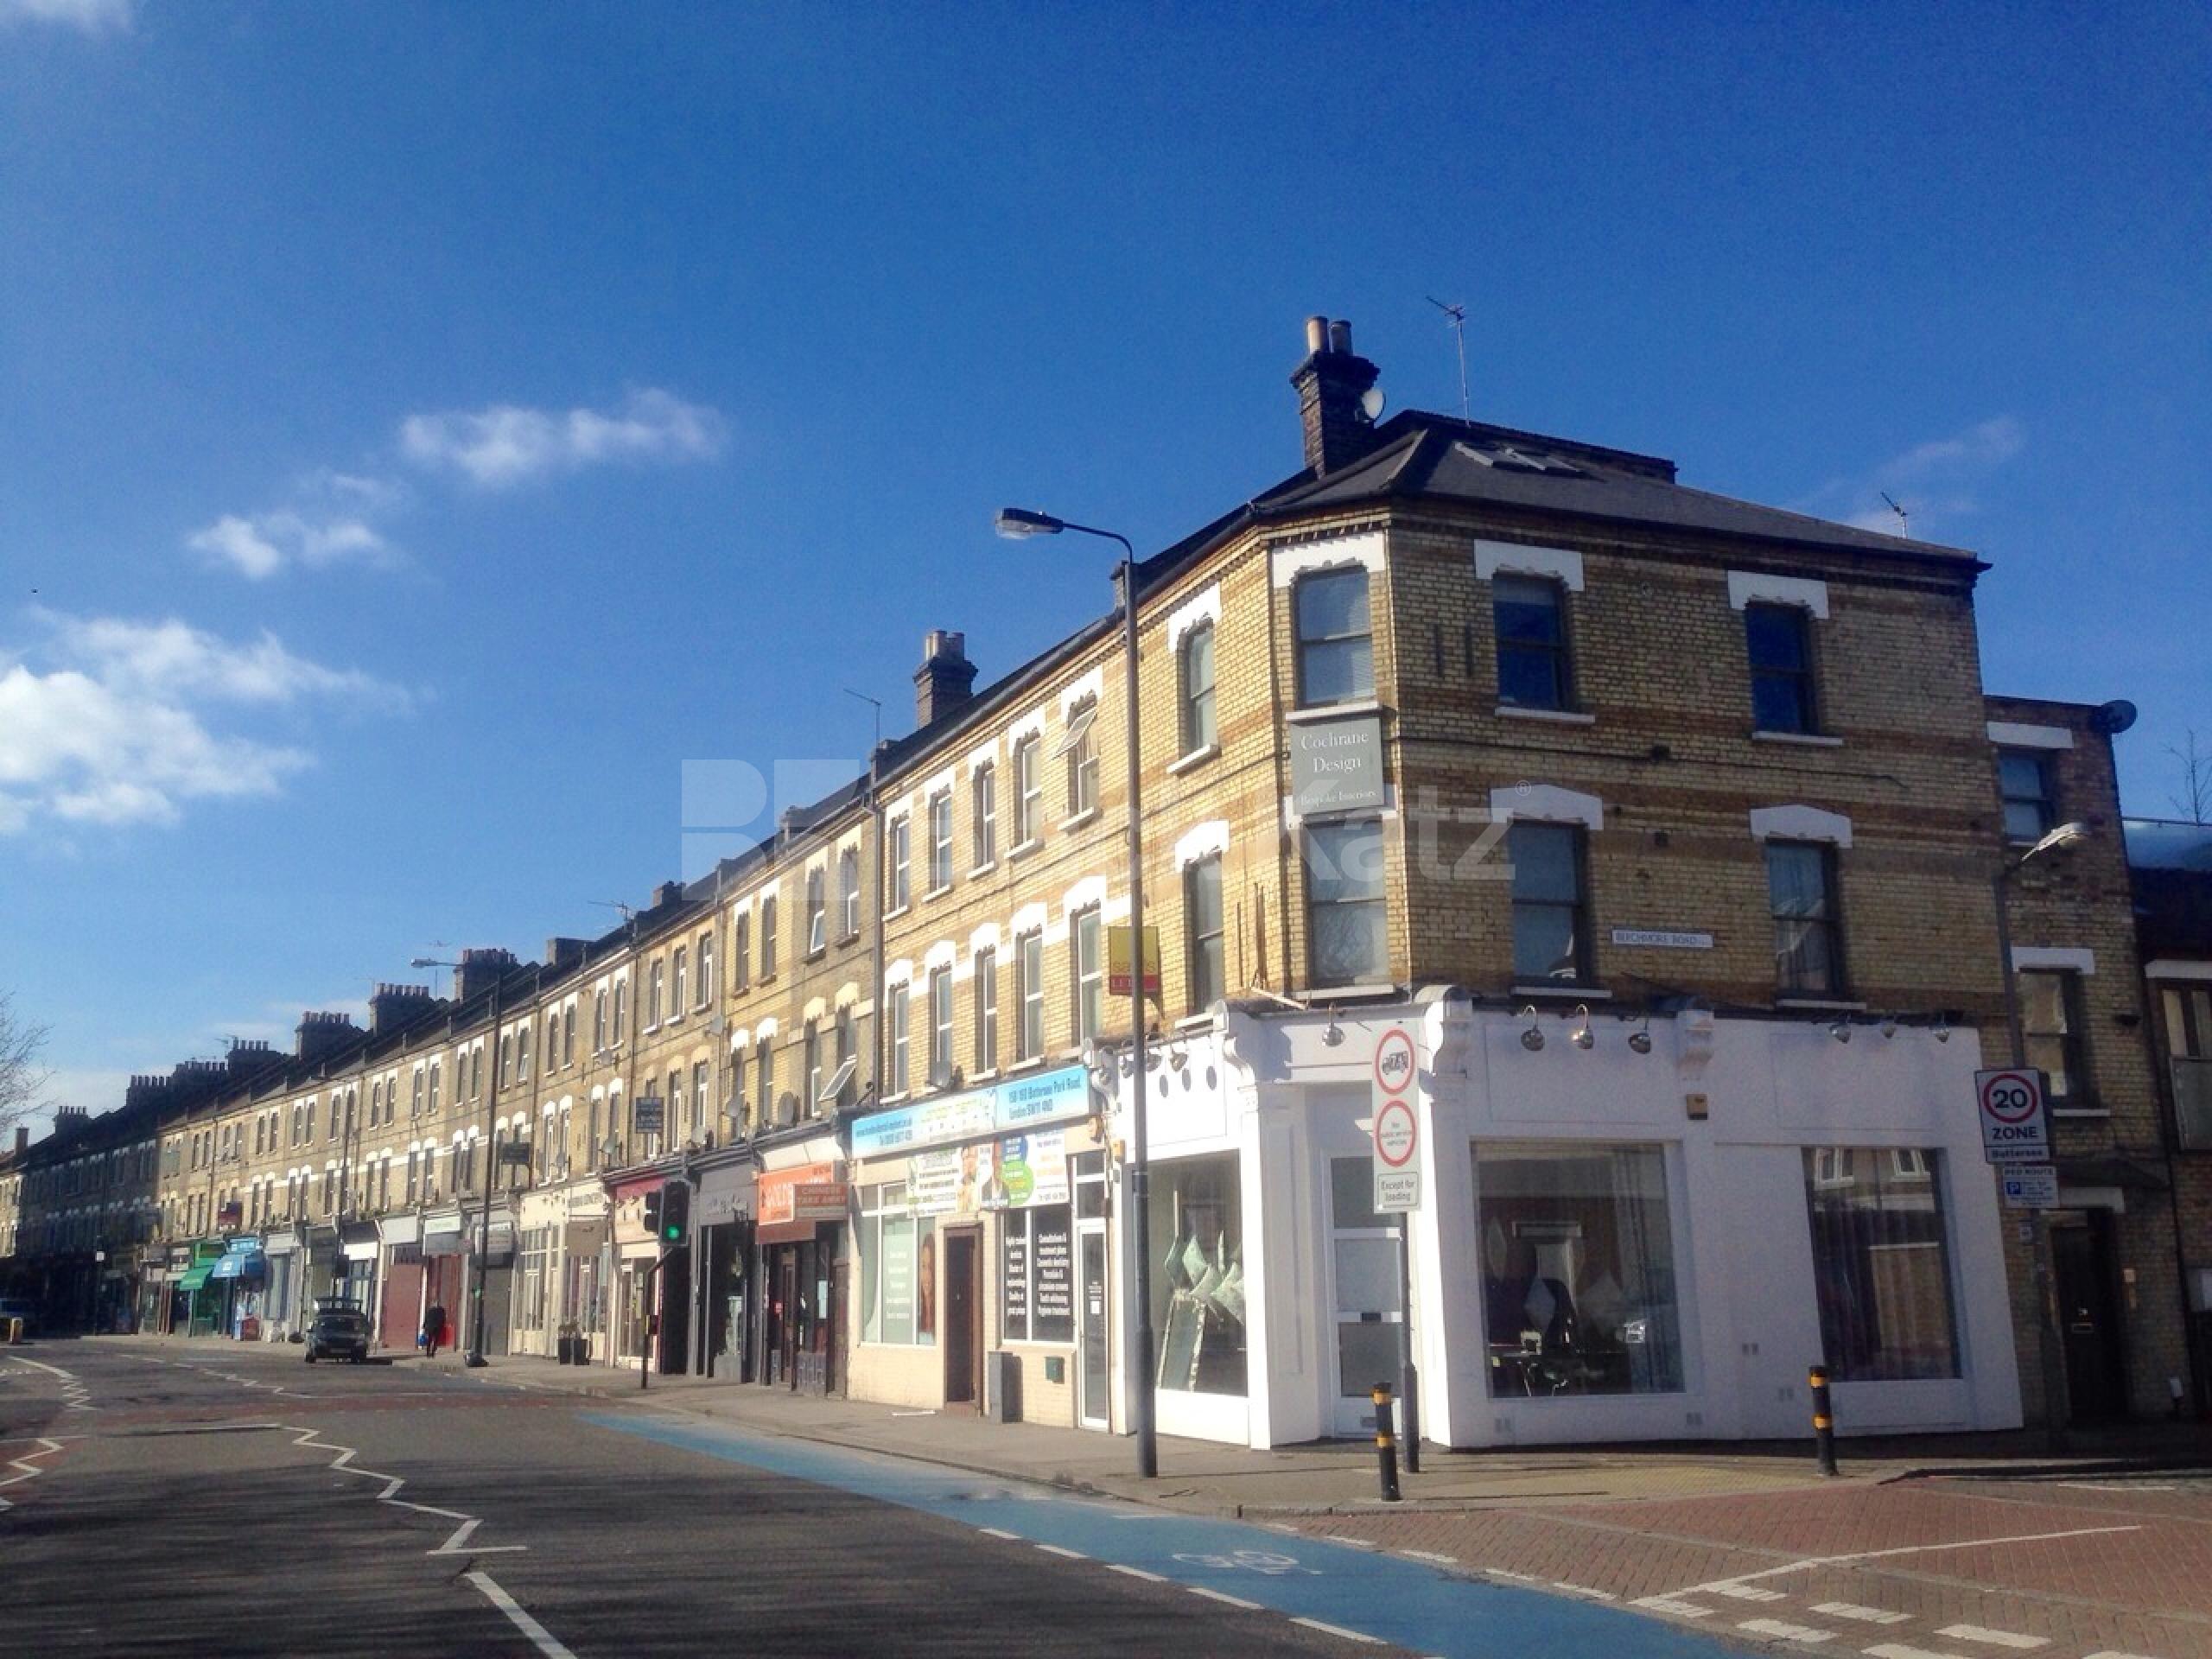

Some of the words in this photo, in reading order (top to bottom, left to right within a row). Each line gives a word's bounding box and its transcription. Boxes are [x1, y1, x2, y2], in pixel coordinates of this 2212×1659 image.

[1300, 732, 1369, 751] Cochrane
[1313, 756, 1361, 774] Design
[1992, 1088, 2028, 1109] 20
[1992, 1126, 2039, 1140] ZONE
[1381, 1180, 1404, 1191] Except
[1405, 1179, 1414, 1189] for
[1385, 1192, 1411, 1202] loading
